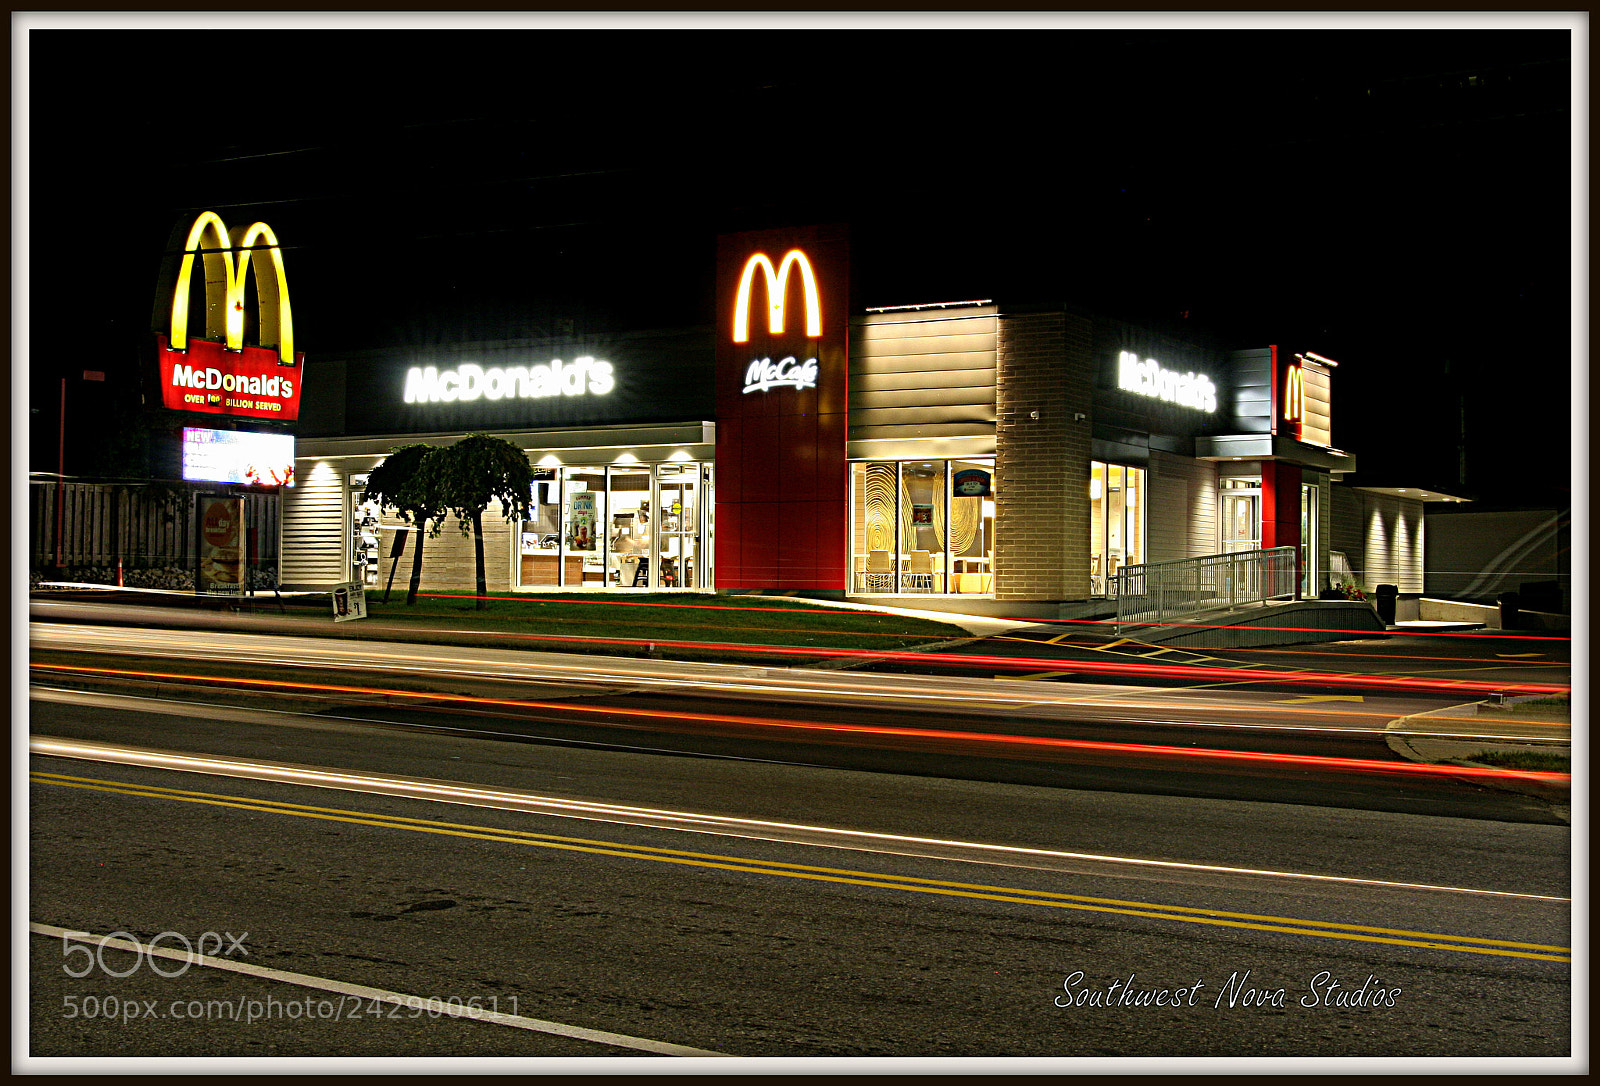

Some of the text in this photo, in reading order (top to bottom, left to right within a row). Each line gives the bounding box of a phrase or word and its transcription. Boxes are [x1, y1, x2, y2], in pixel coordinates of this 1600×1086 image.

[172, 364, 293, 398] McDonald's
[404, 356, 615, 404] McDonald's
[1118, 351, 1217, 413] McDonald's
[184, 394, 205, 404] OVER
[226, 399, 254, 409] BILLION
[255, 401, 282, 412] SERVED
